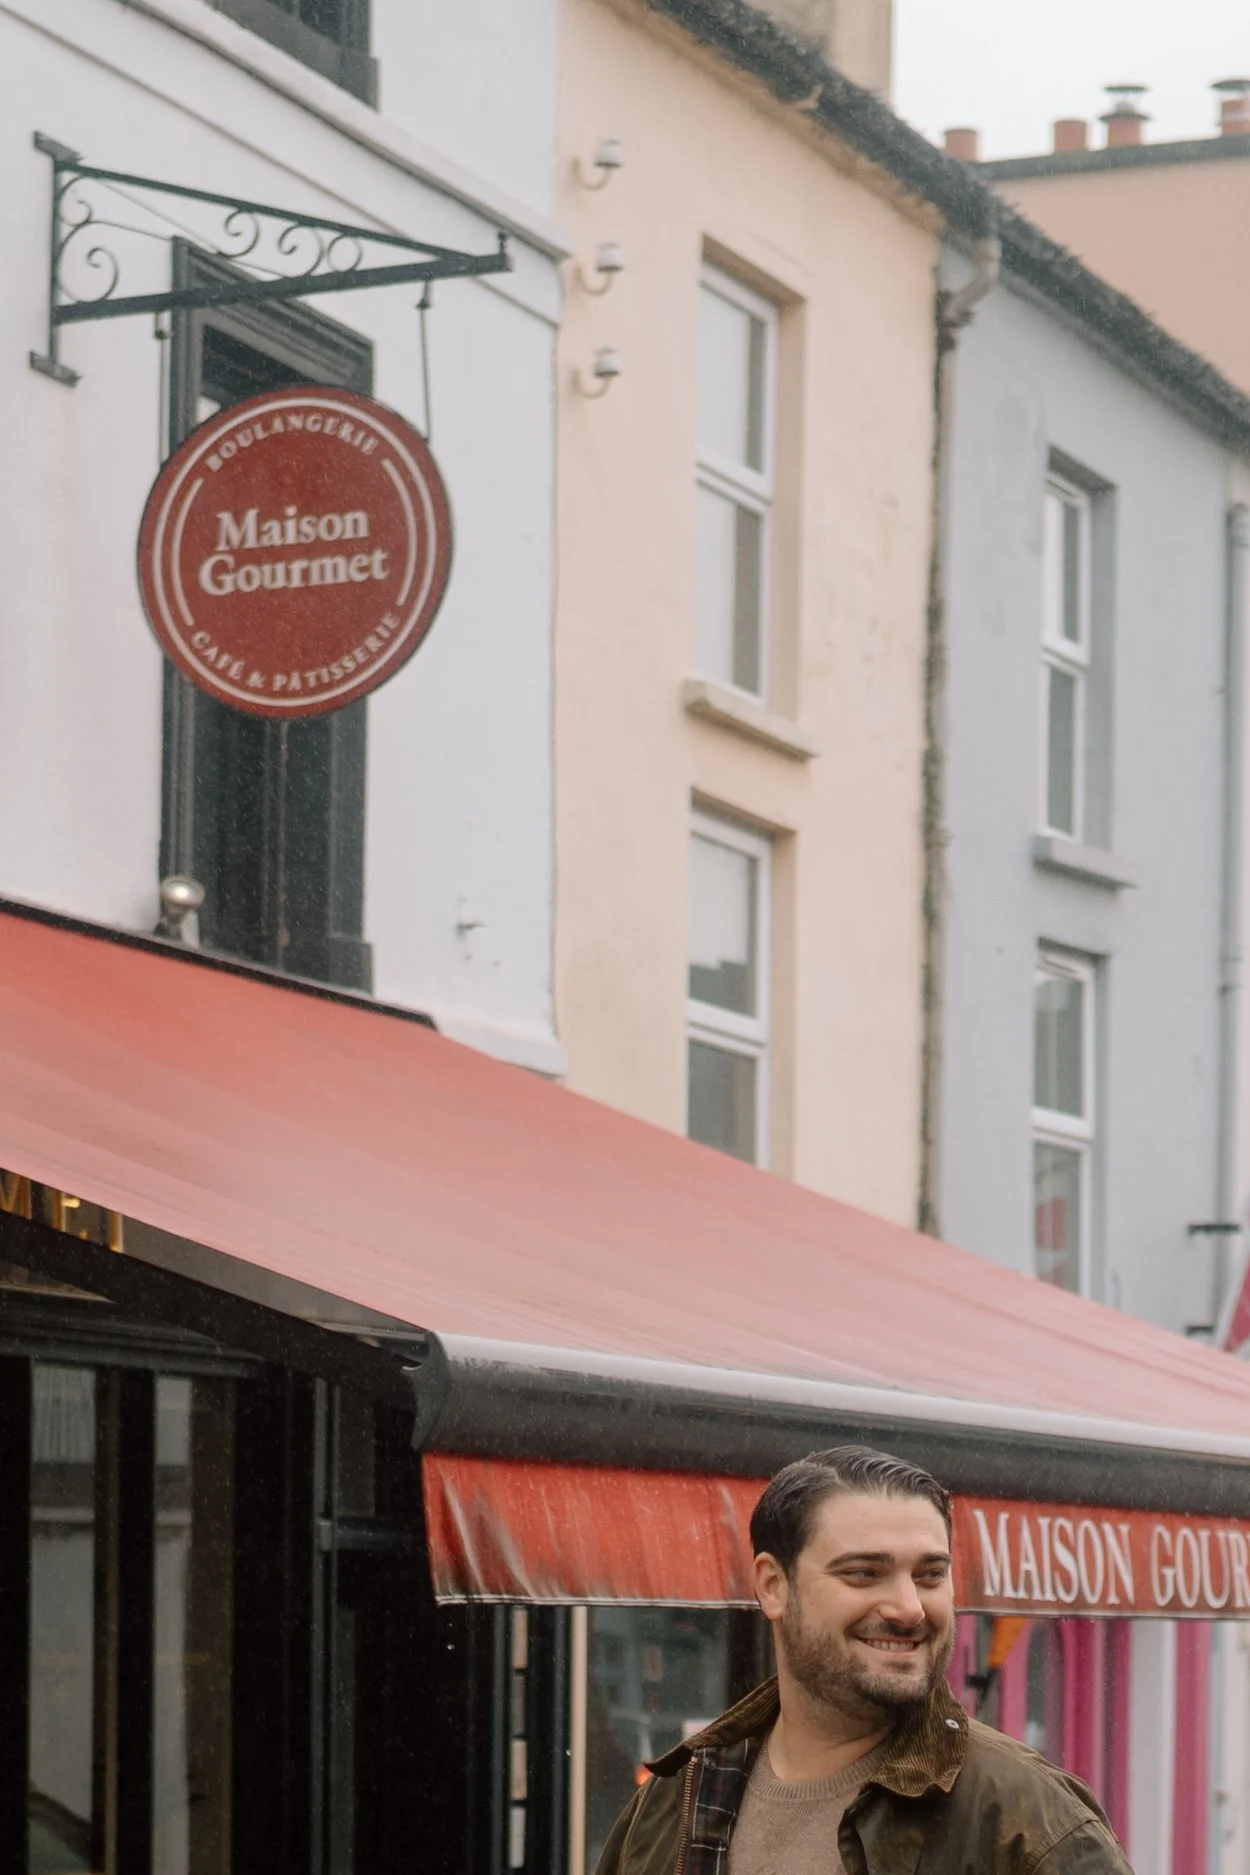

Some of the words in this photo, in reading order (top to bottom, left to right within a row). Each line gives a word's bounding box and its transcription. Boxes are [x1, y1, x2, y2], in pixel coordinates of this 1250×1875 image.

[205, 413, 379, 472] BOULANGERIE
[215, 505, 369, 552] Maison
[200, 549, 389, 596] Gourmet
[248, 669, 265, 689] &
[972, 1508, 1134, 1604] MAISON
